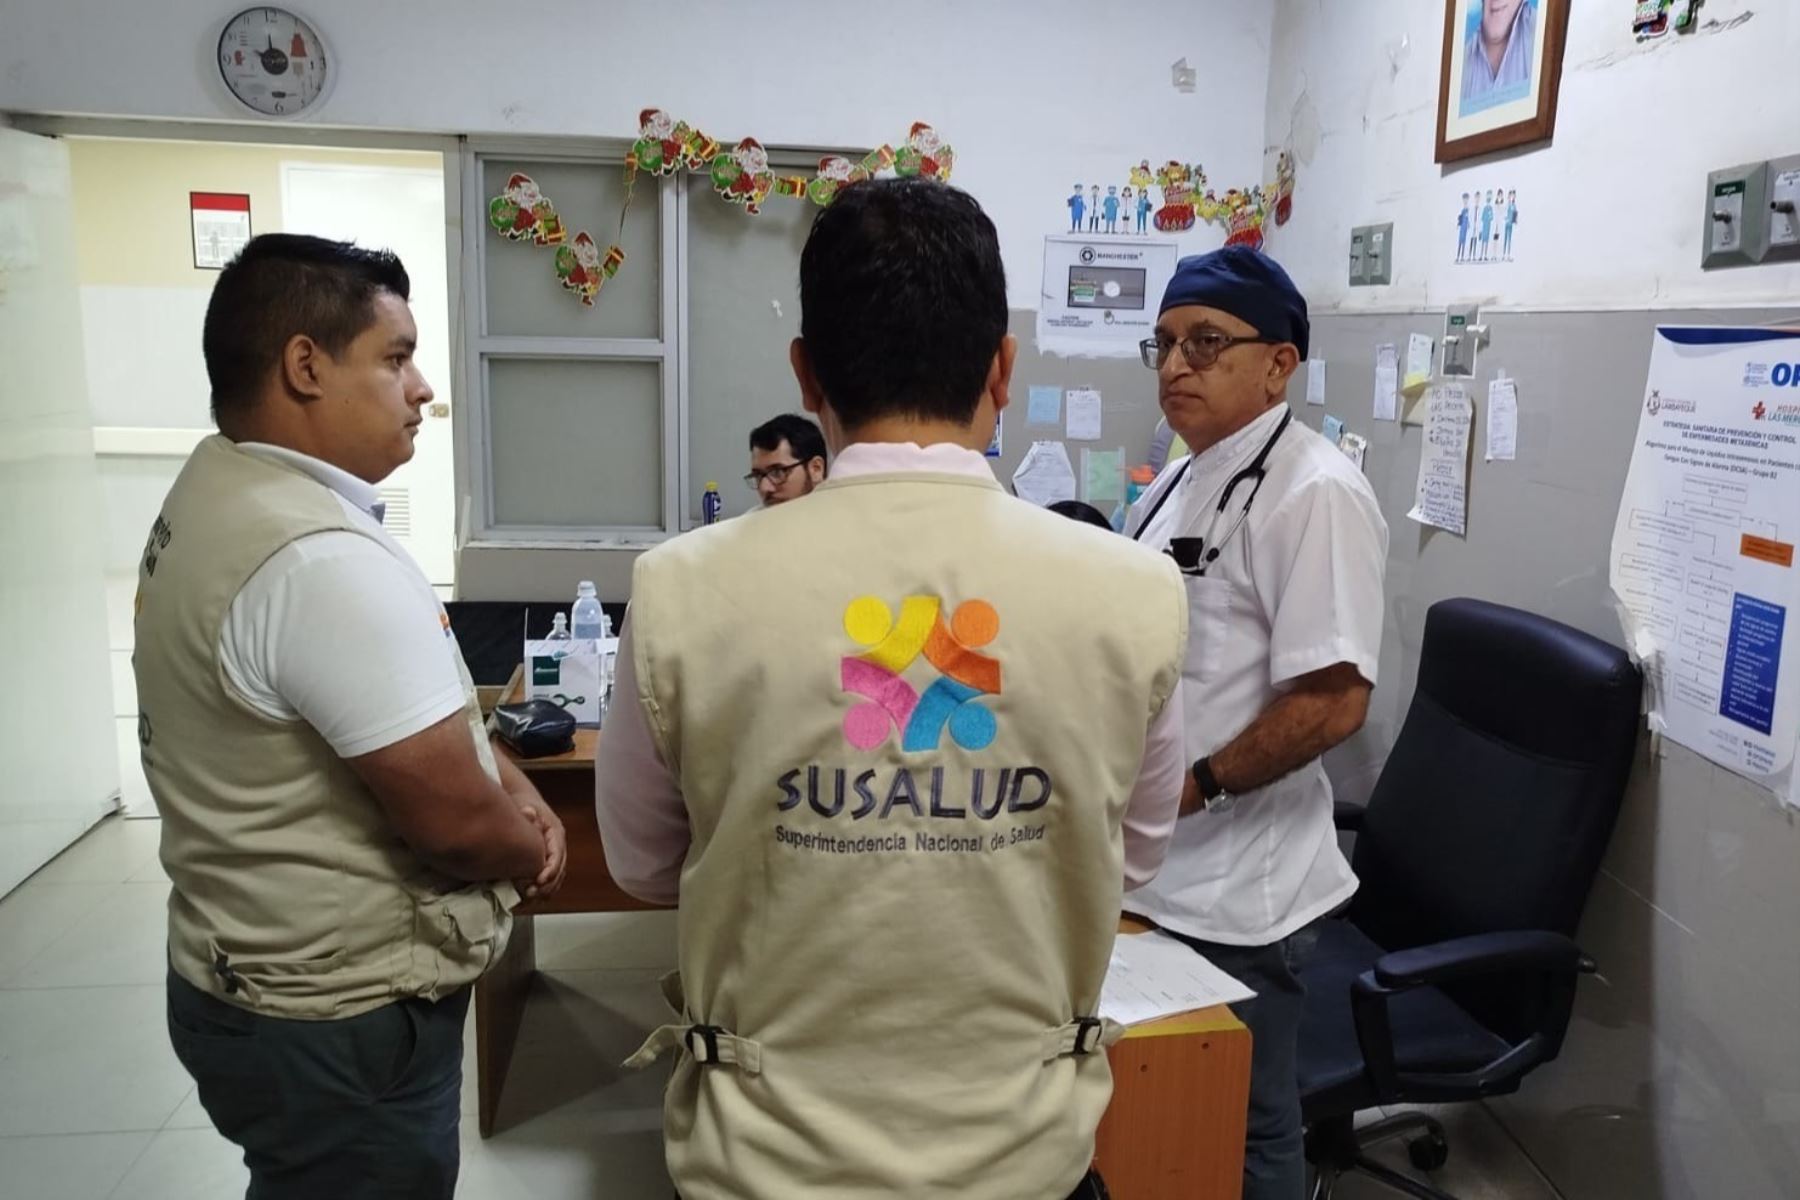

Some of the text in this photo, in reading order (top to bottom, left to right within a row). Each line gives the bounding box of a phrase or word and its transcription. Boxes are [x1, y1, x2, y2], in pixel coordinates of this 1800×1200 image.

[777, 765, 1052, 820] SUSALUD
[776, 824, 1046, 853] Superintendencia Nacional de Salud
